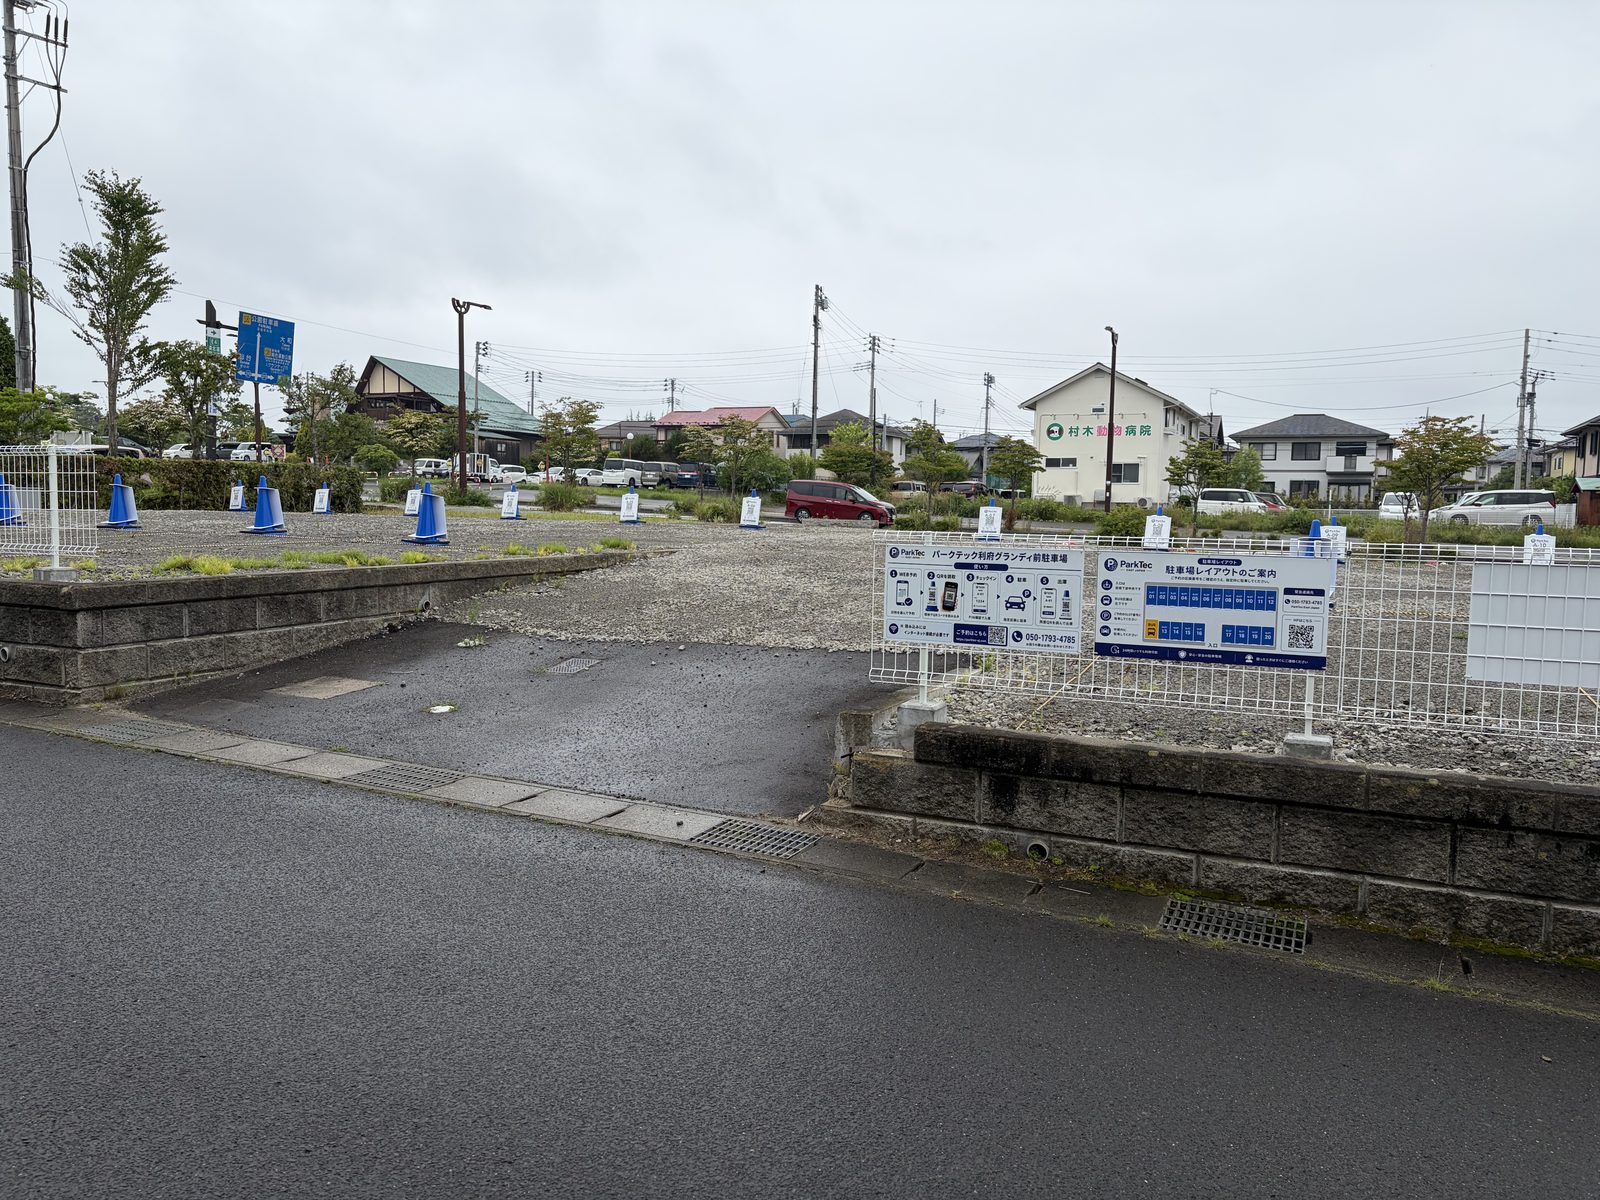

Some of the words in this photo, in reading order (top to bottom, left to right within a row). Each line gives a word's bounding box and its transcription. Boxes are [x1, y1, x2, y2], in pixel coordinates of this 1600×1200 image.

[1068, 424, 1152, 437] 村木動物病院
[932, 550, 1068, 563] パークテック利府グランディ前駐車場
[1120, 560, 1152, 568] ParkTec
[1165, 565, 1277, 578] 駐車場レイアウトのご案内
[1026, 633, 1076, 644] 050-1793-4785
